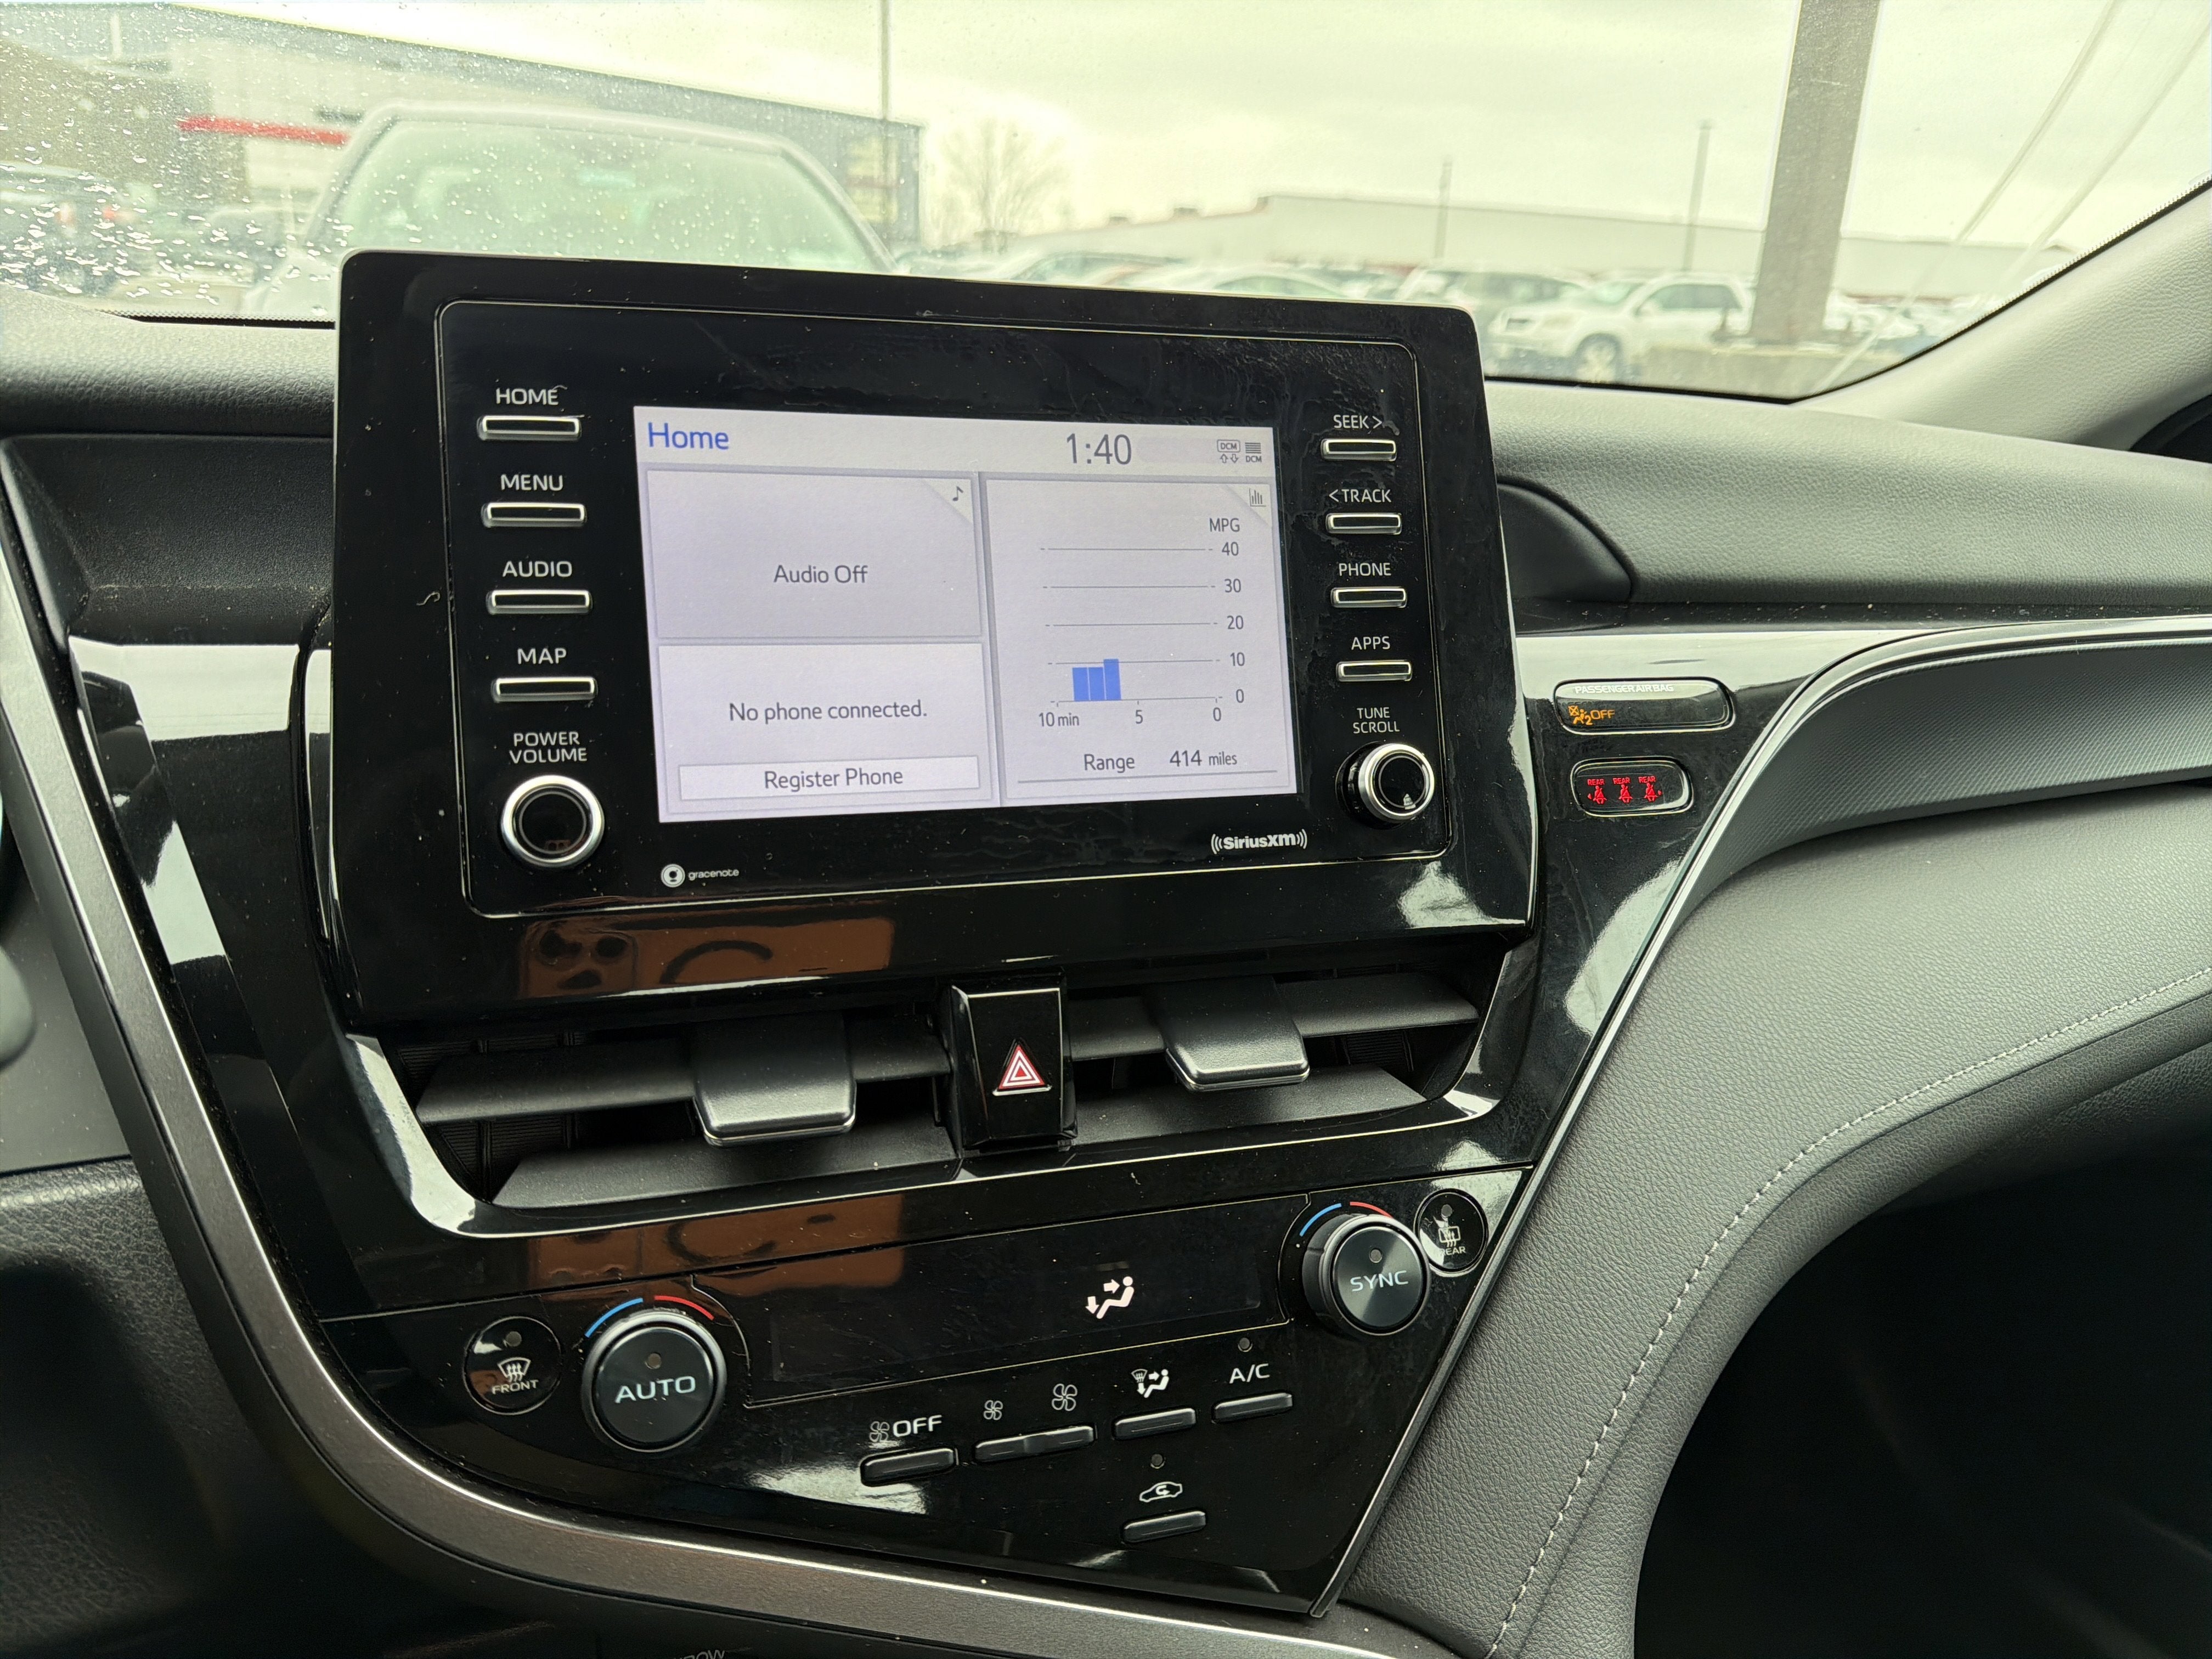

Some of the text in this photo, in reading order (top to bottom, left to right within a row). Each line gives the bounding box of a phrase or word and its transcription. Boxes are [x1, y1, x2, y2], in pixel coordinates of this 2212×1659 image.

[496, 387, 558, 405] HOME
[648, 422, 729, 449] Home
[1067, 433, 1131, 465] 1:40
[501, 475, 563, 490] MENU
[1210, 518, 1239, 532] MPG
[1222, 542, 1238, 556] 40
[503, 561, 572, 577] AUDIO
[774, 565, 867, 583] Audio Off
[1339, 563, 1391, 575] PHONE
[1224, 579, 1241, 592] 30
[1227, 616, 1243, 629] 20
[1352, 636, 1390, 650] APPS
[518, 648, 566, 664] MAP
[1231, 652, 1245, 666] 10
[1236, 689, 1244, 703] 0
[1575, 685, 1635, 694] PASSENGER
[730, 699, 927, 724] No phone connected.
[1136, 710, 1143, 724] 5
[1213, 707, 1221, 721] 0
[1357, 707, 1390, 719] TUNE
[1039, 712, 1079, 726] 10 min
[1353, 721, 1400, 733] SCROLL
[514, 732, 579, 746] POWER
[510, 748, 587, 763] VOLUME
[1084, 750, 1237, 773] Range 414 miles
[765, 768, 902, 792] Register Phone
[1638, 775, 1656, 783] REAR
[689, 870, 739, 881] gracenote
[1441, 1246, 1466, 1256] REAR
[1350, 1269, 1409, 1293] SYNC
[1229, 1364, 1269, 1383] A/C
[491, 1379, 539, 1395] FRONT
[616, 1376, 695, 1403] AUTO
[893, 1415, 941, 1437] OFF
